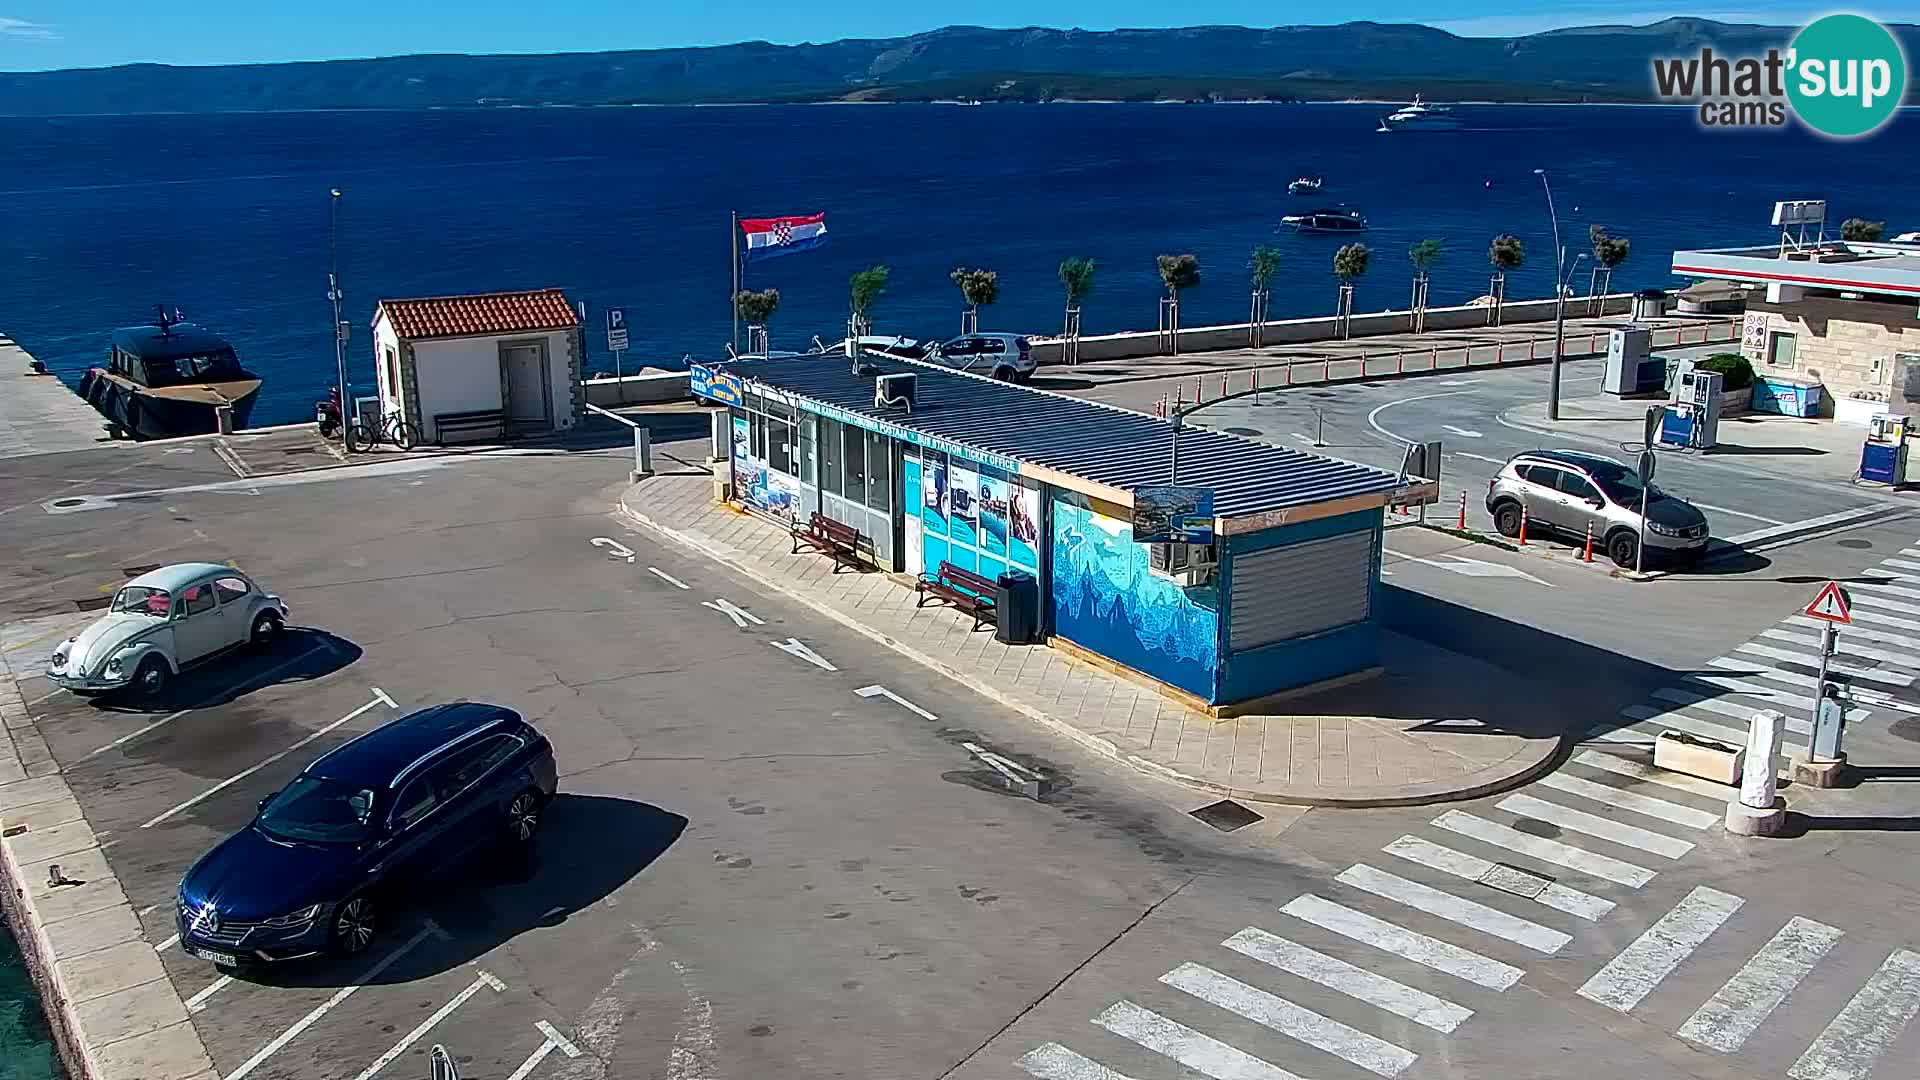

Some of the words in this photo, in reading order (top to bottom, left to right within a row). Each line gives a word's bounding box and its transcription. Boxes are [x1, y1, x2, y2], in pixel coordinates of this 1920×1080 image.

[611, 310, 622, 327] P
[879, 424, 909, 440] POSTAJA
[917, 432, 931, 448] BUS
[931, 438, 962, 457] STATION
[964, 448, 989, 464] TICKET
[990, 456, 1016, 471] OFFICE
